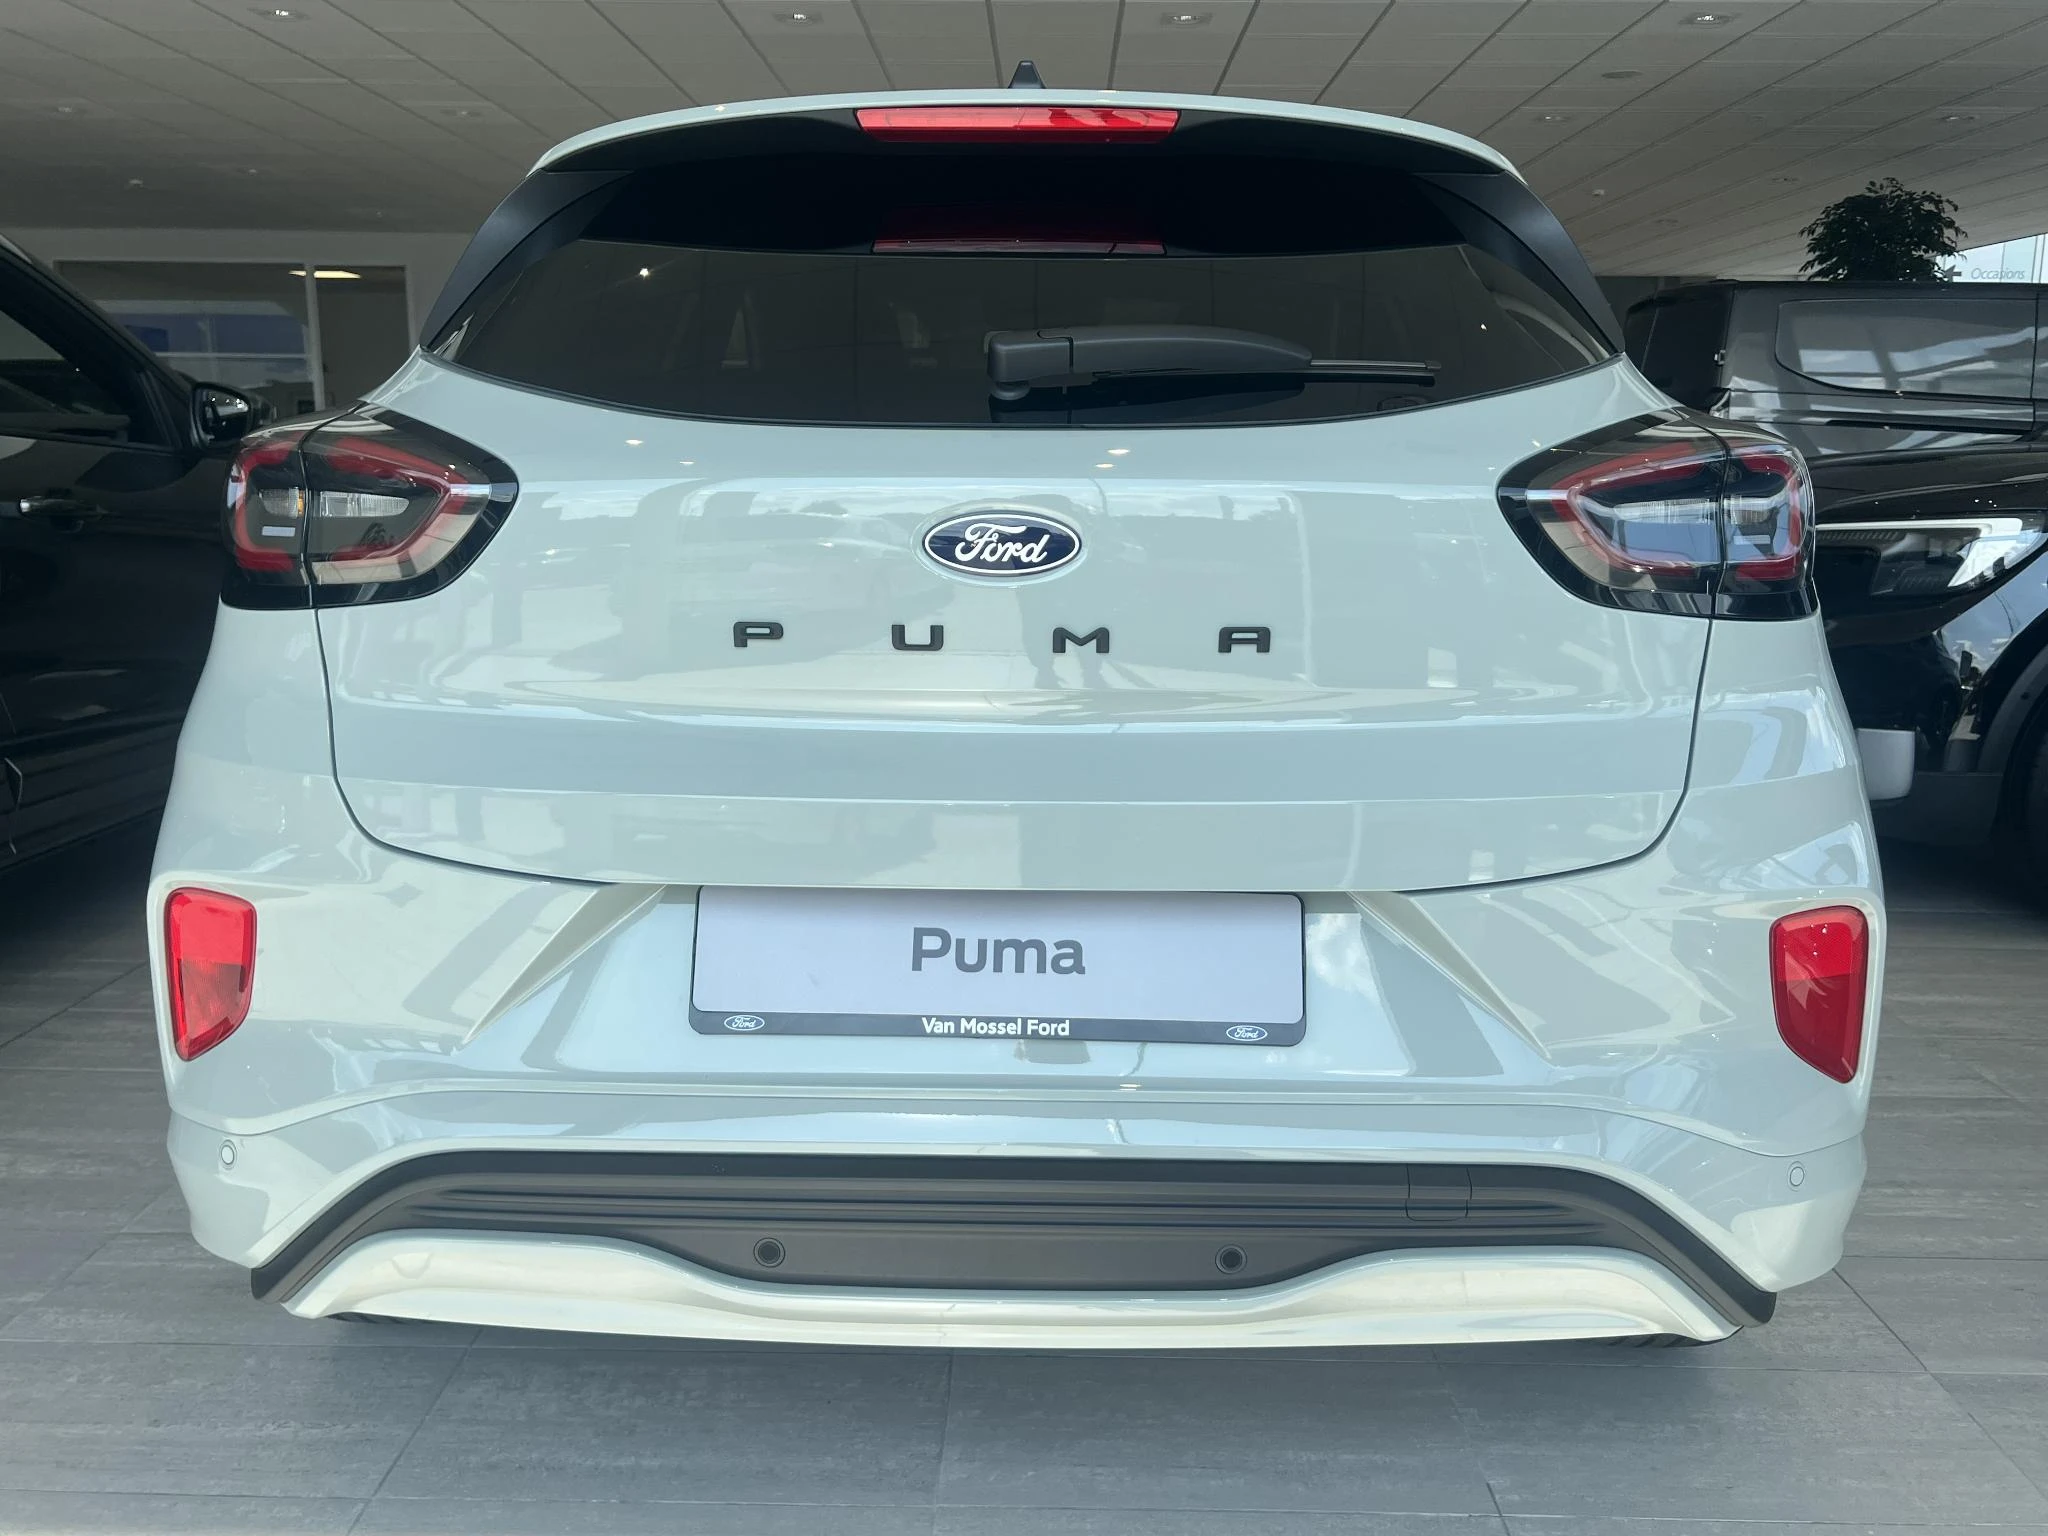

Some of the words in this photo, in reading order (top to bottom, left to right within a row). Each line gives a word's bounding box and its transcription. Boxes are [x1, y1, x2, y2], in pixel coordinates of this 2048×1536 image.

[1971, 268, 2025, 280] Occasions
[954, 523, 1050, 563] Ford
[733, 621, 1271, 654] PUMA
[911, 926, 1085, 975] Puma
[732, 1016, 756, 1028] Ford
[921, 1017, 955, 1034] Van
[960, 1017, 1022, 1035] Mossel
[1027, 1019, 1070, 1036] Ford
[1234, 1028, 1259, 1039] Ford
